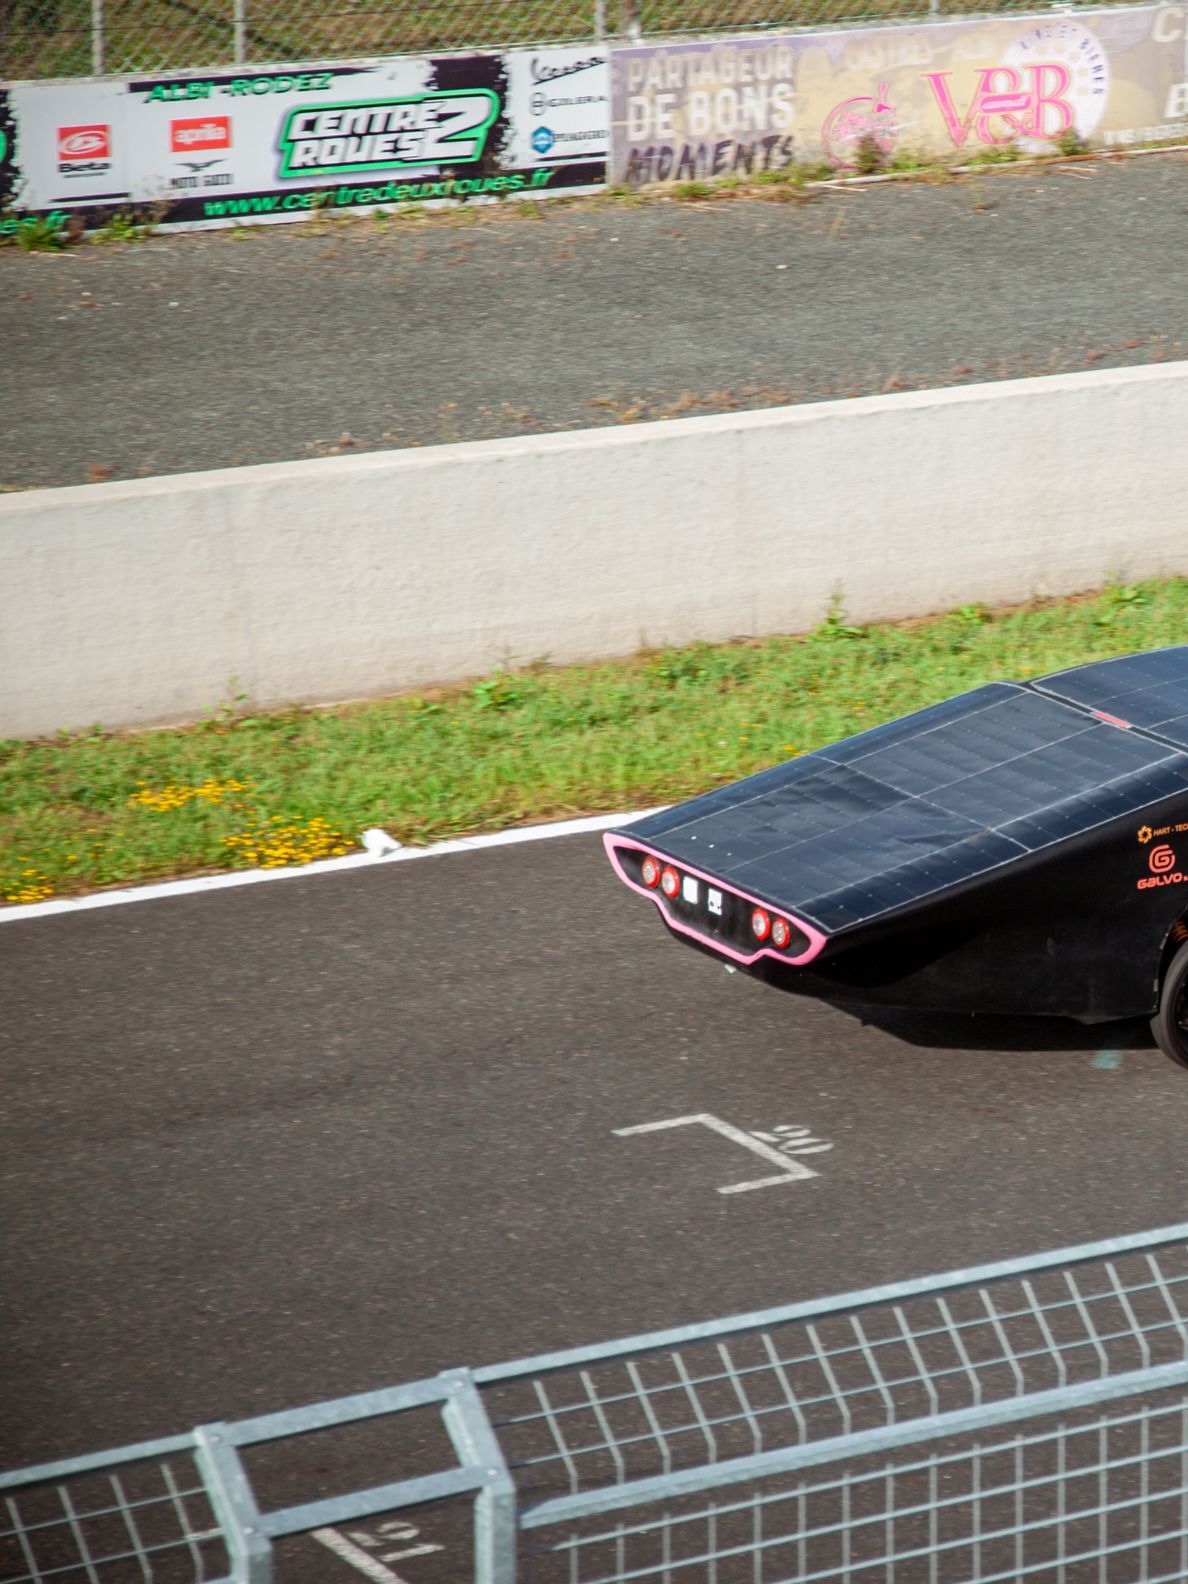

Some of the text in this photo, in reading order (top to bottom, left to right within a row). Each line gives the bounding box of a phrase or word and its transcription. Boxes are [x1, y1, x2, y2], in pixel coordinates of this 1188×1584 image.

[146, 81, 214, 102] ALBI
[626, 82, 795, 141] DE BONS
[174, 122, 228, 145] aprilia
[287, 95, 493, 161] CENTRE 2
[287, 132, 424, 170] ROUES
[58, 161, 111, 173] Beta
